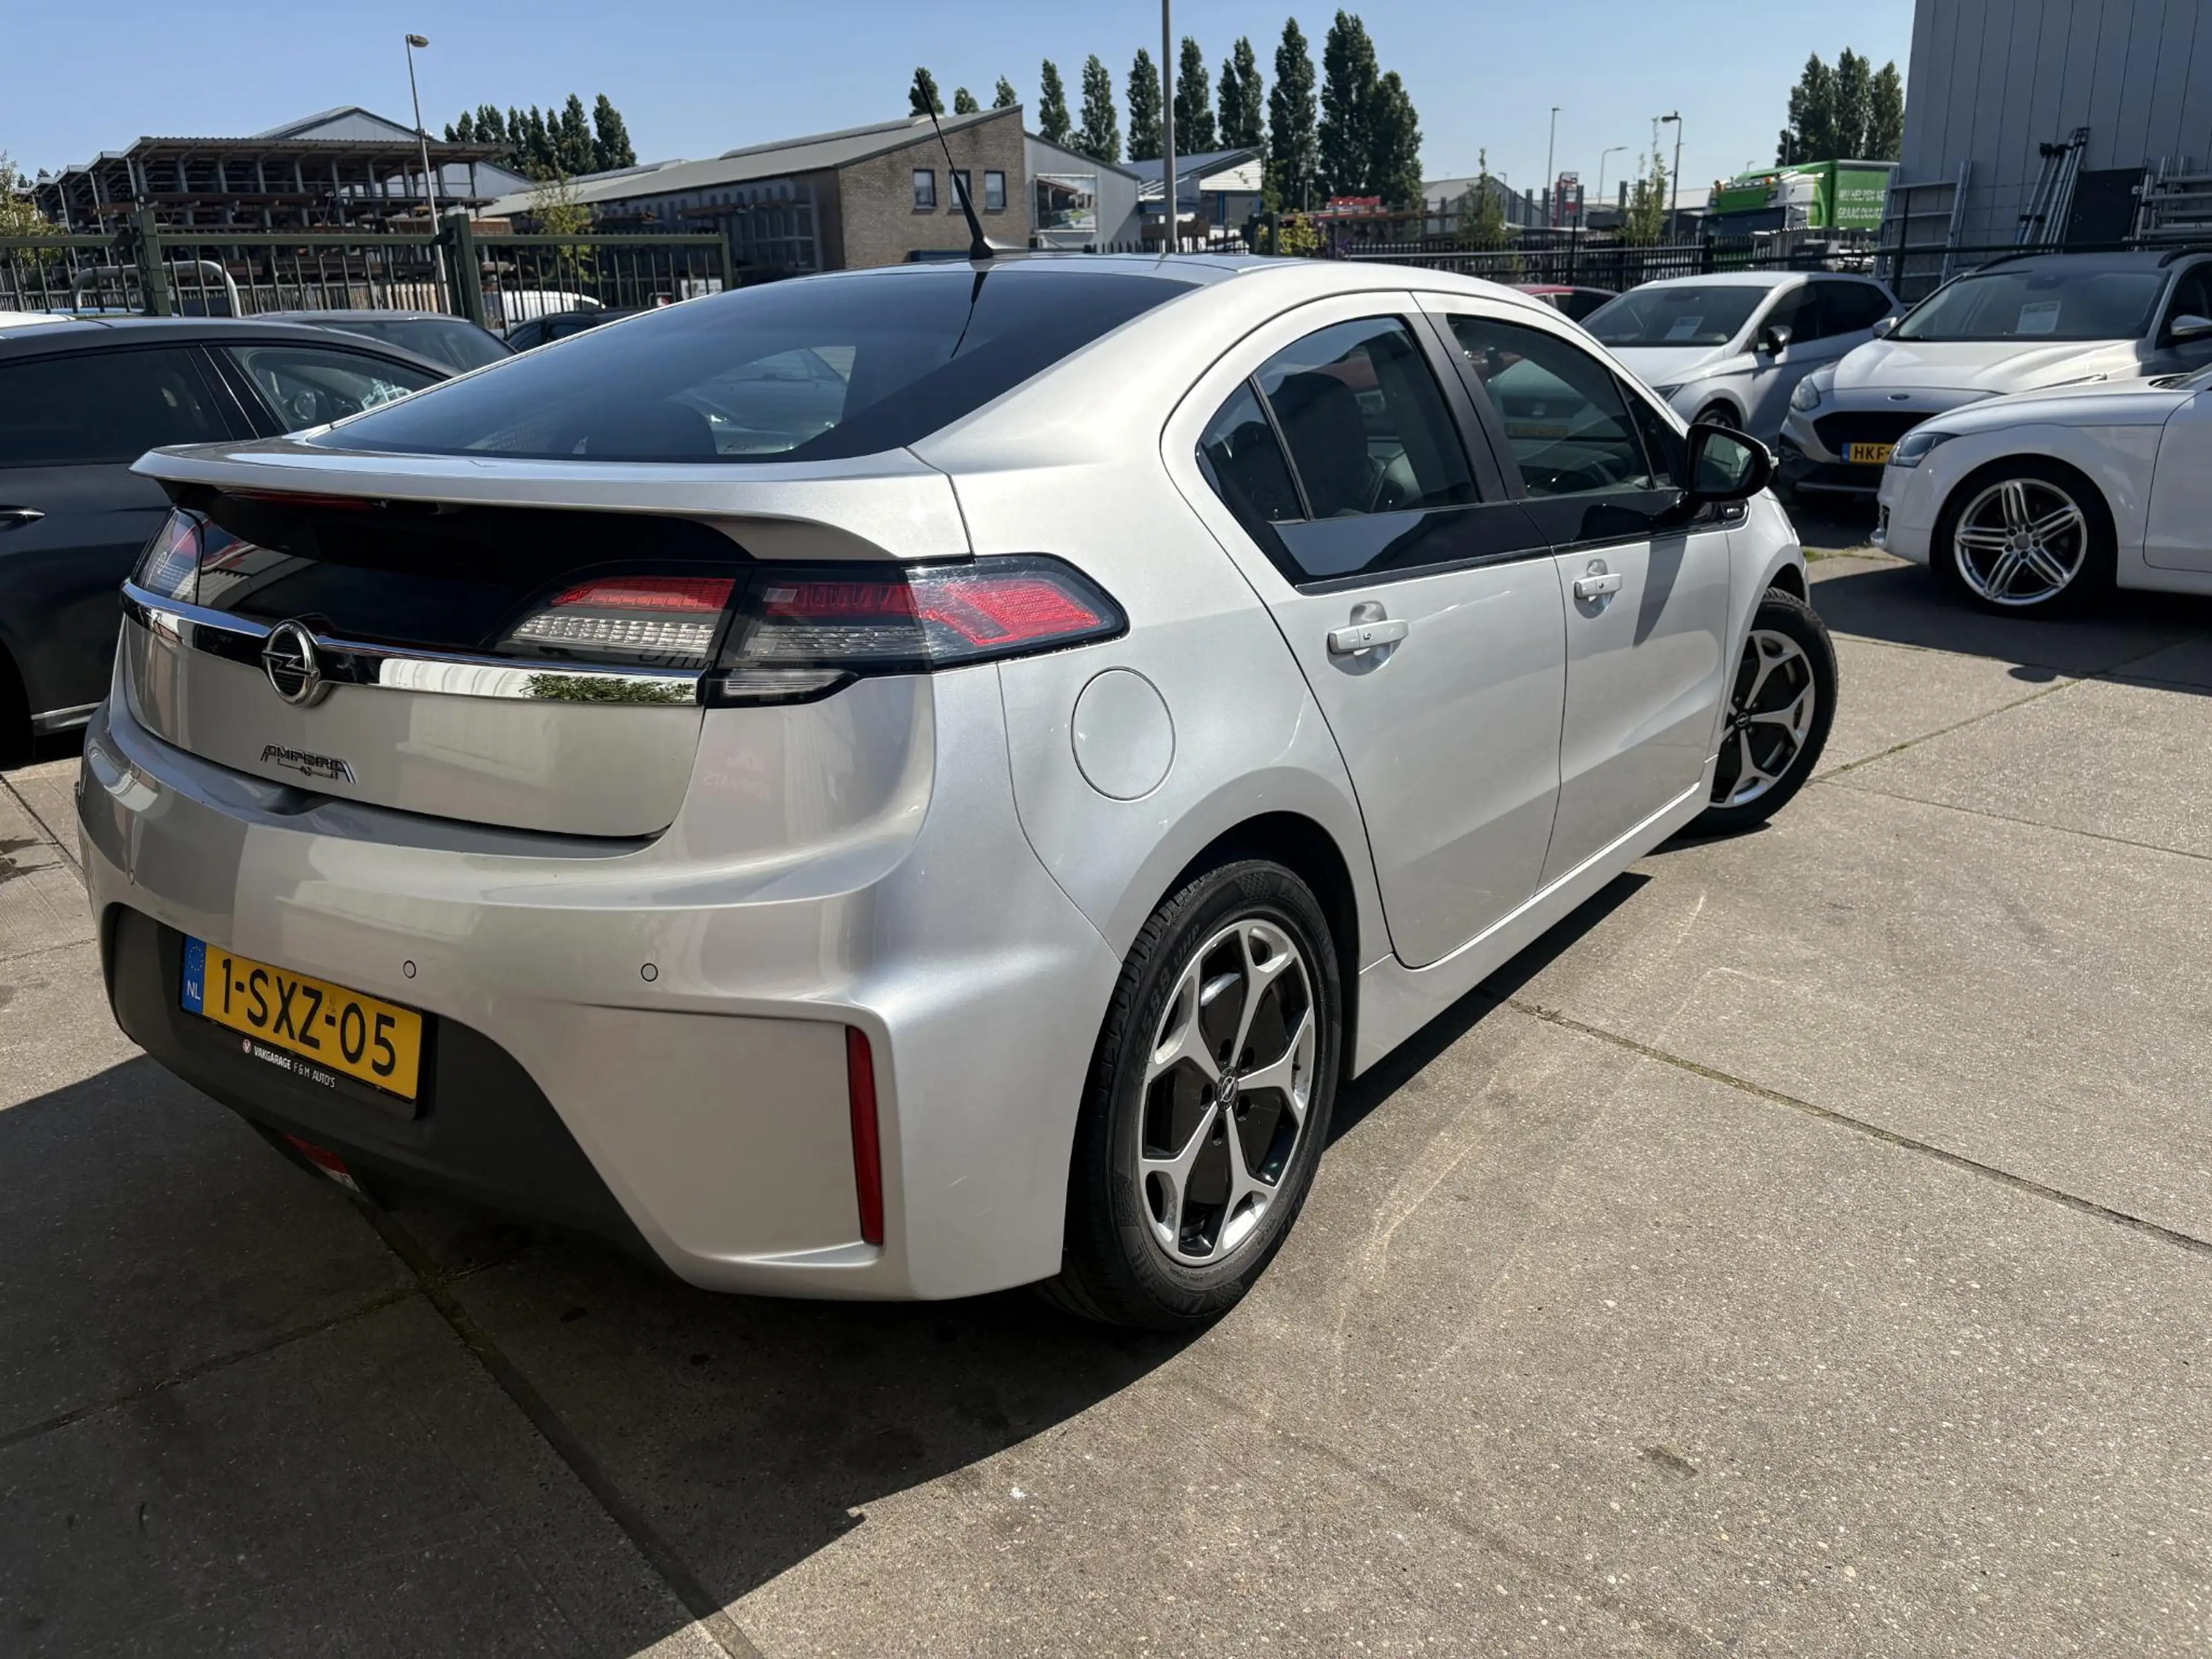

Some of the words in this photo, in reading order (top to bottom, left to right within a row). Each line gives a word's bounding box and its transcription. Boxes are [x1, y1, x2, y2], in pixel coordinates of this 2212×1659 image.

[260, 744, 357, 785] AMPERA
[187, 979, 201, 1001] NL
[222, 958, 396, 1077] 1-SXZ-05
[254, 1046, 291, 1070] VAKGARAGE
[312, 1070, 335, 1088] AUTO'S
